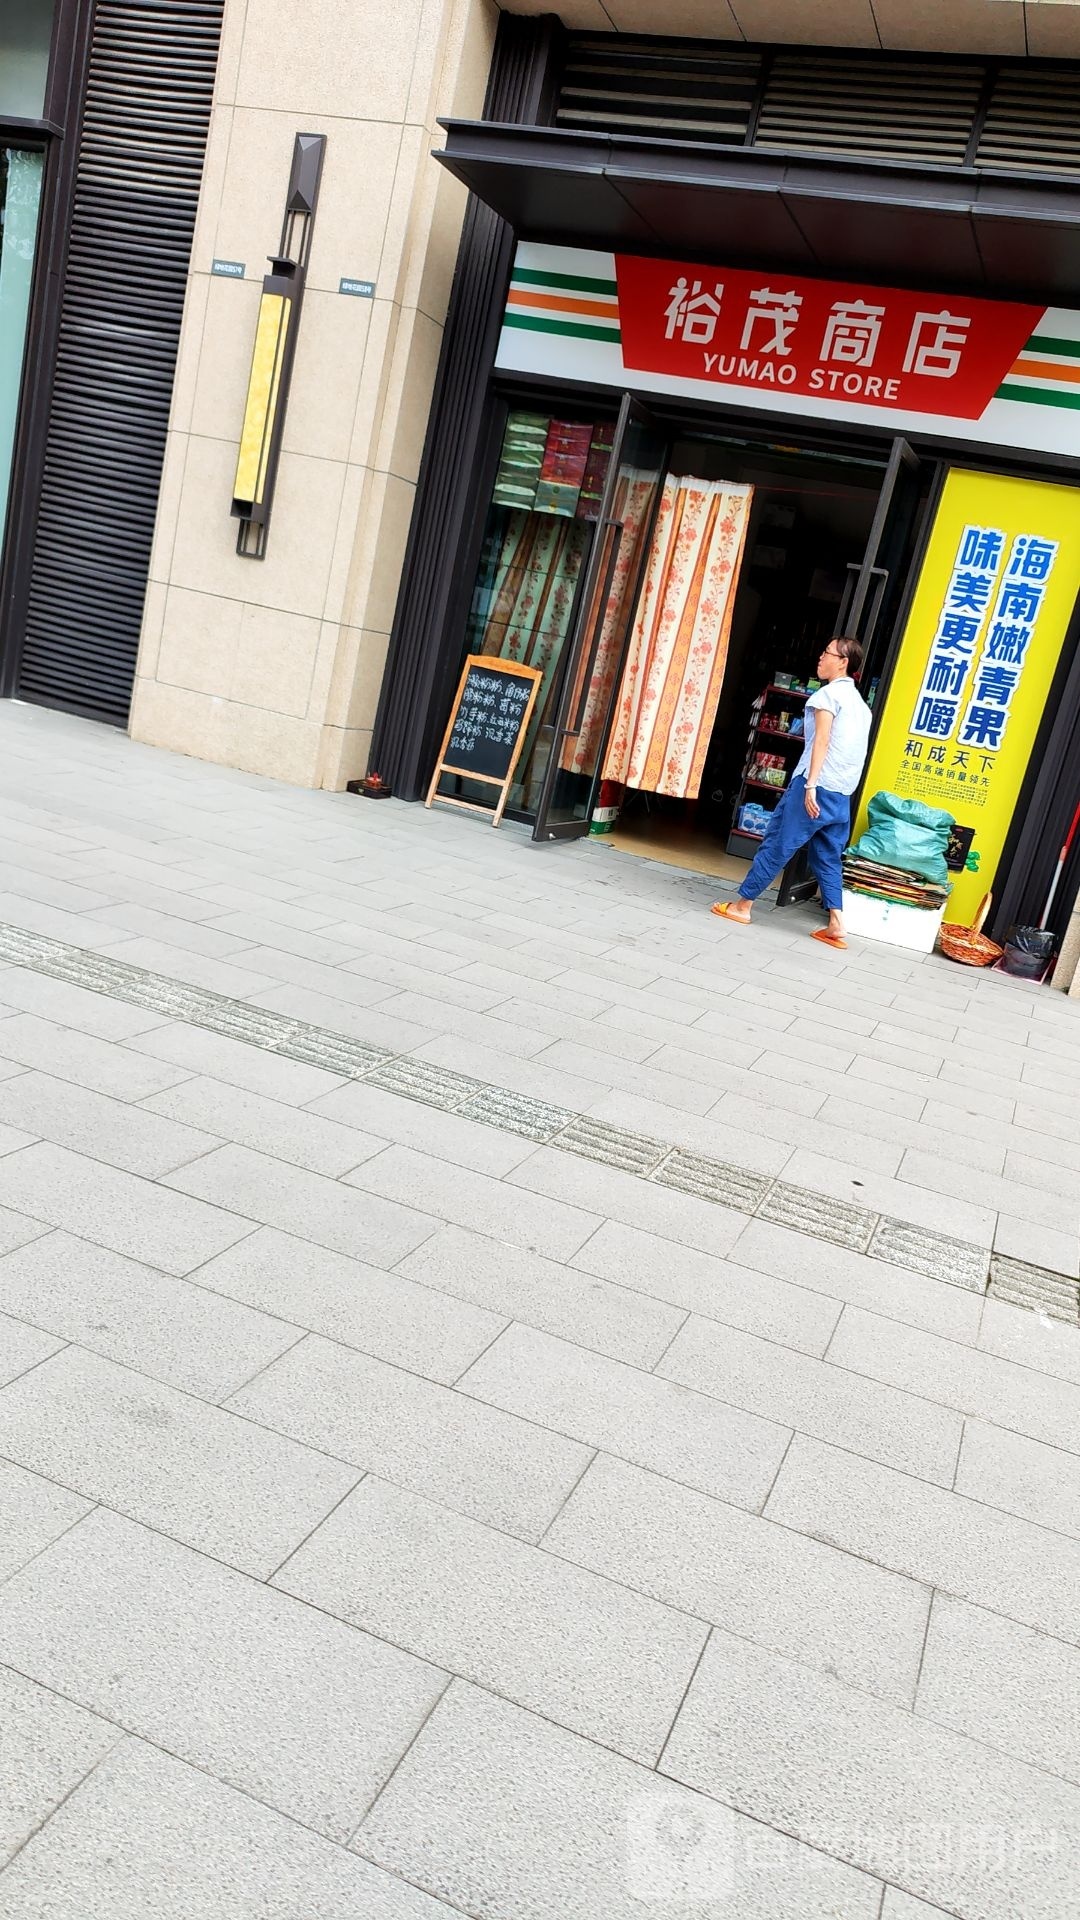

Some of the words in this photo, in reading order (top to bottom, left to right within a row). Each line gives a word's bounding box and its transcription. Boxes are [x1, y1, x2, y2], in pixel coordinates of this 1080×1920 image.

[664, 276, 971, 378] 裕茂商店
[703, 352, 797, 385] YUMAO
[808, 368, 901, 400] STORE
[914, 529, 1001, 736] 味美更耐嚼
[961, 536, 1055, 748] 海南嫩青果
[900, 759, 990, 787] 全国高端销量领先
[903, 739, 996, 773] 和成天下
